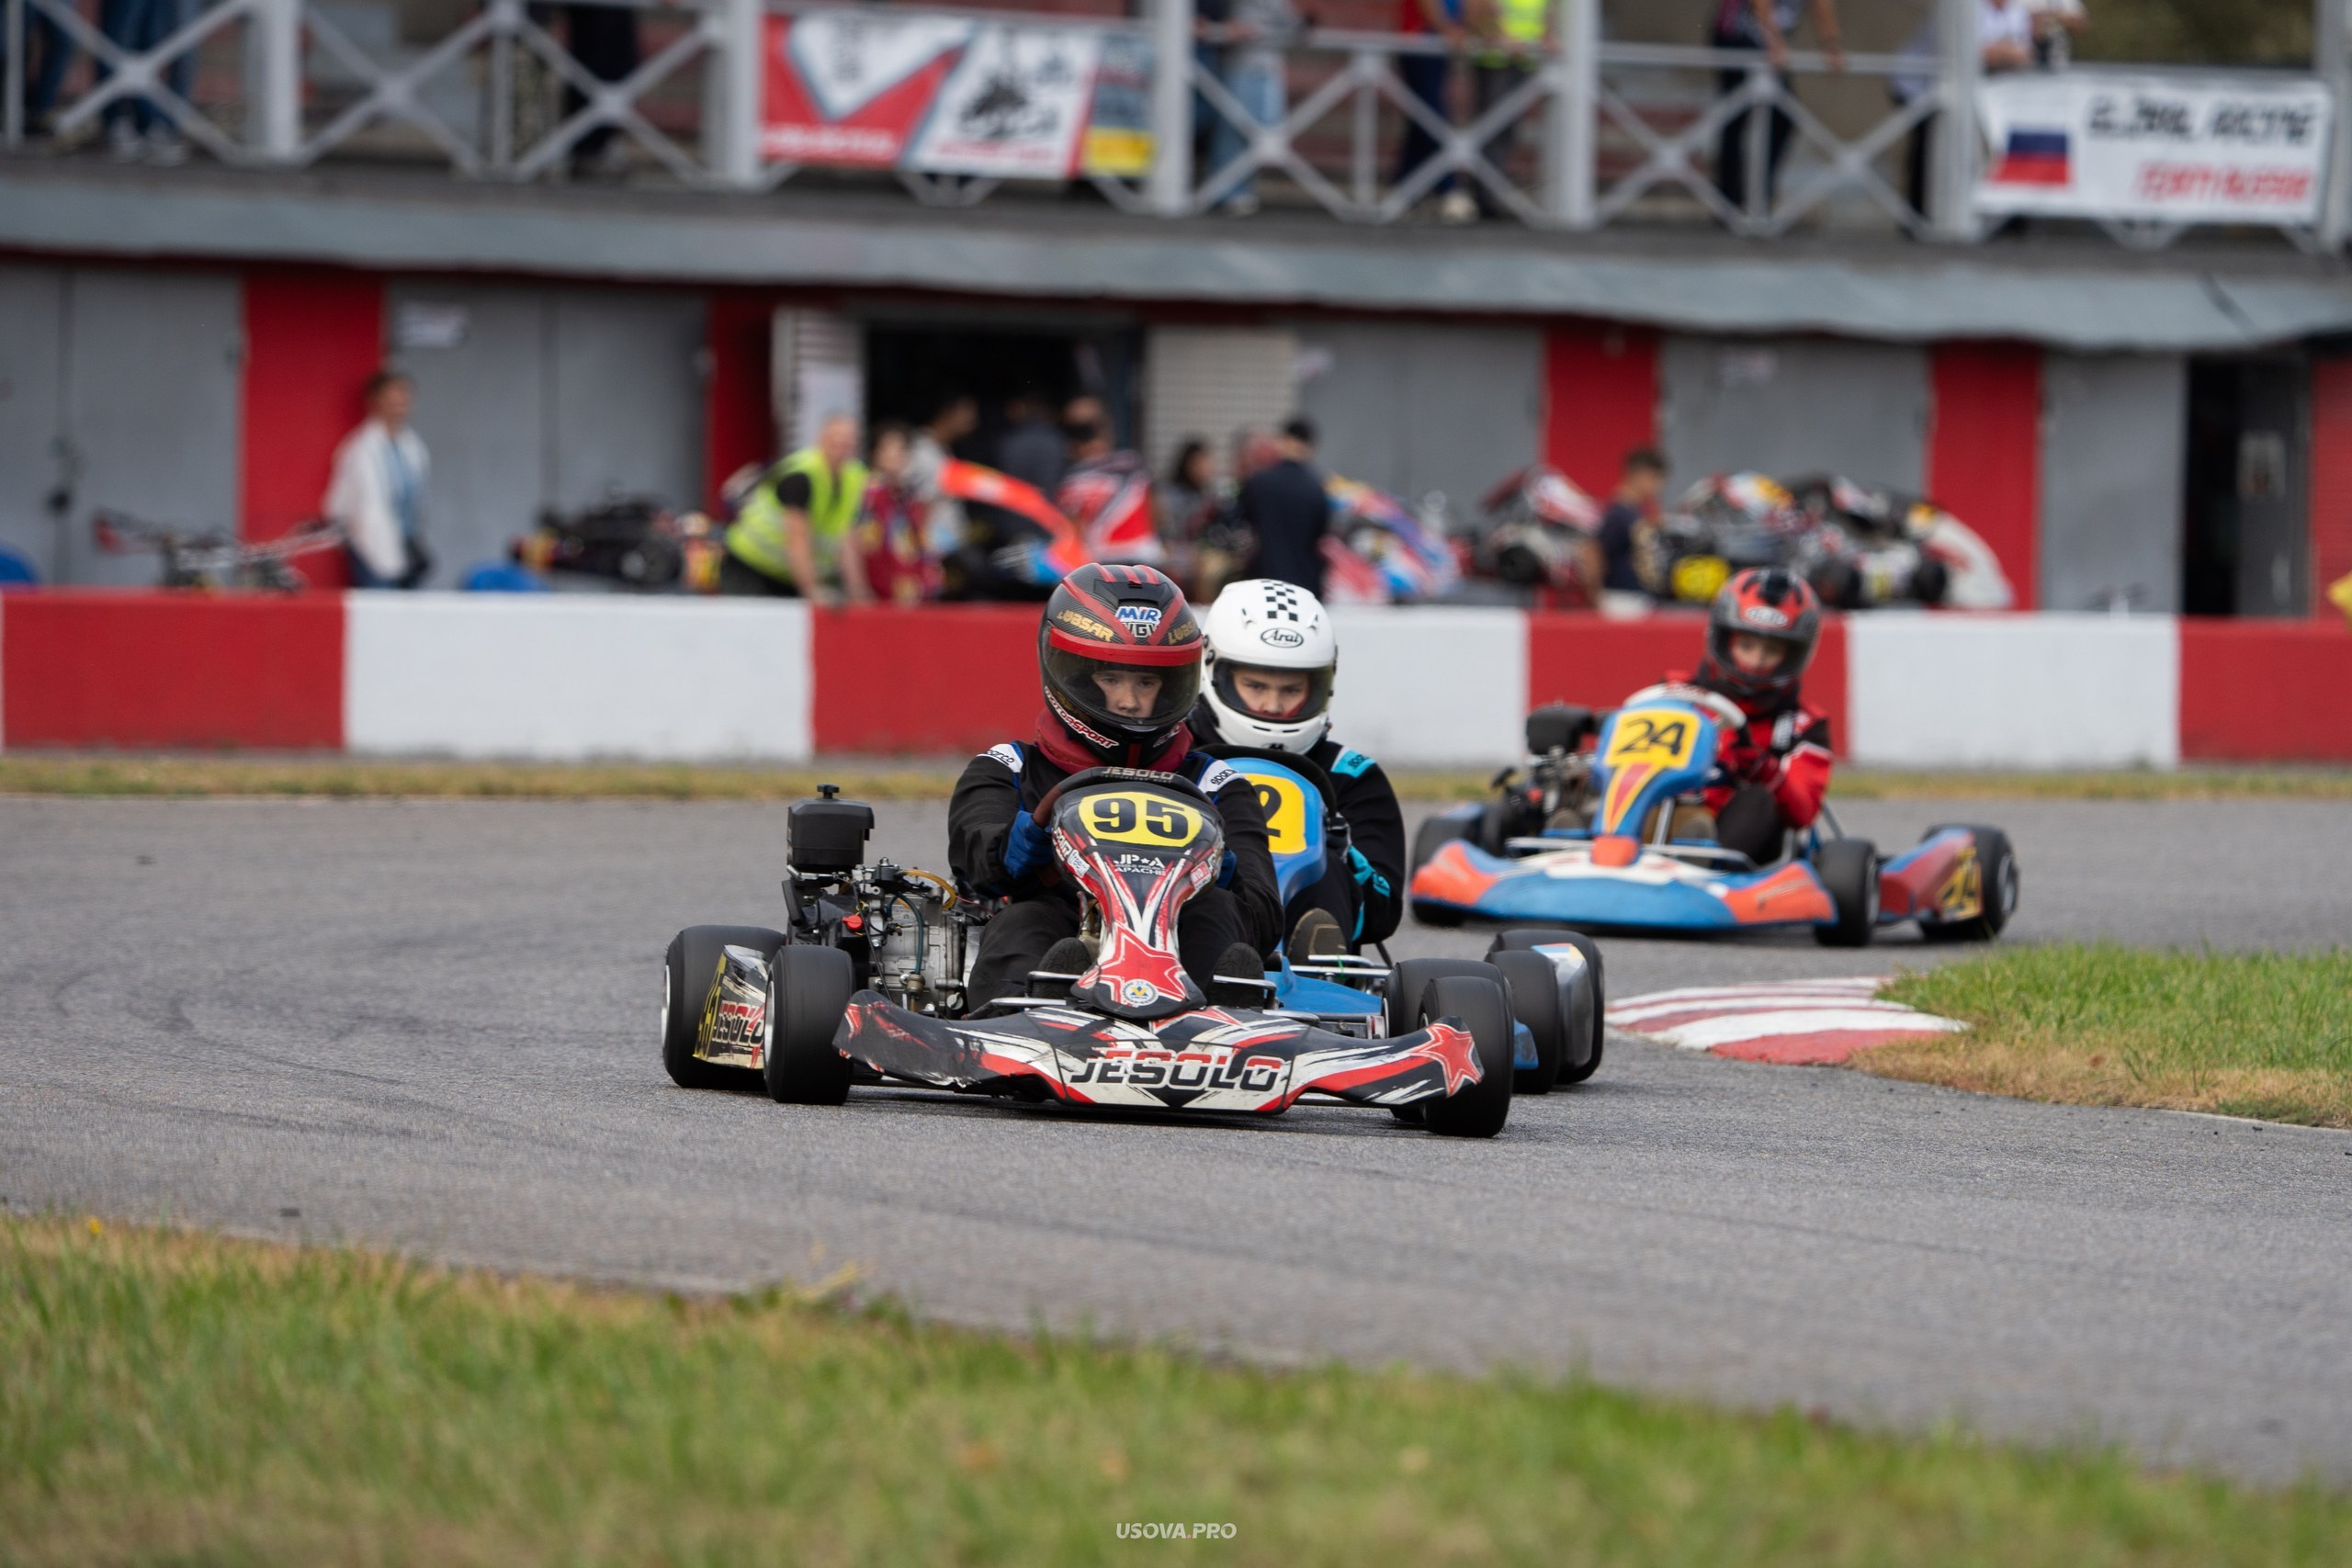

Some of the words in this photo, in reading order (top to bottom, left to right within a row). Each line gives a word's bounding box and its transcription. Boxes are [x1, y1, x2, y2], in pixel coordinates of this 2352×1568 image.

[1262, 629, 1299, 643] Arai
[1616, 717, 1686, 756] 24
[1102, 765, 1176, 781] JESOLO
[1093, 797, 1189, 840] 95
[1069, 1049, 1284, 1092] JESOLO
